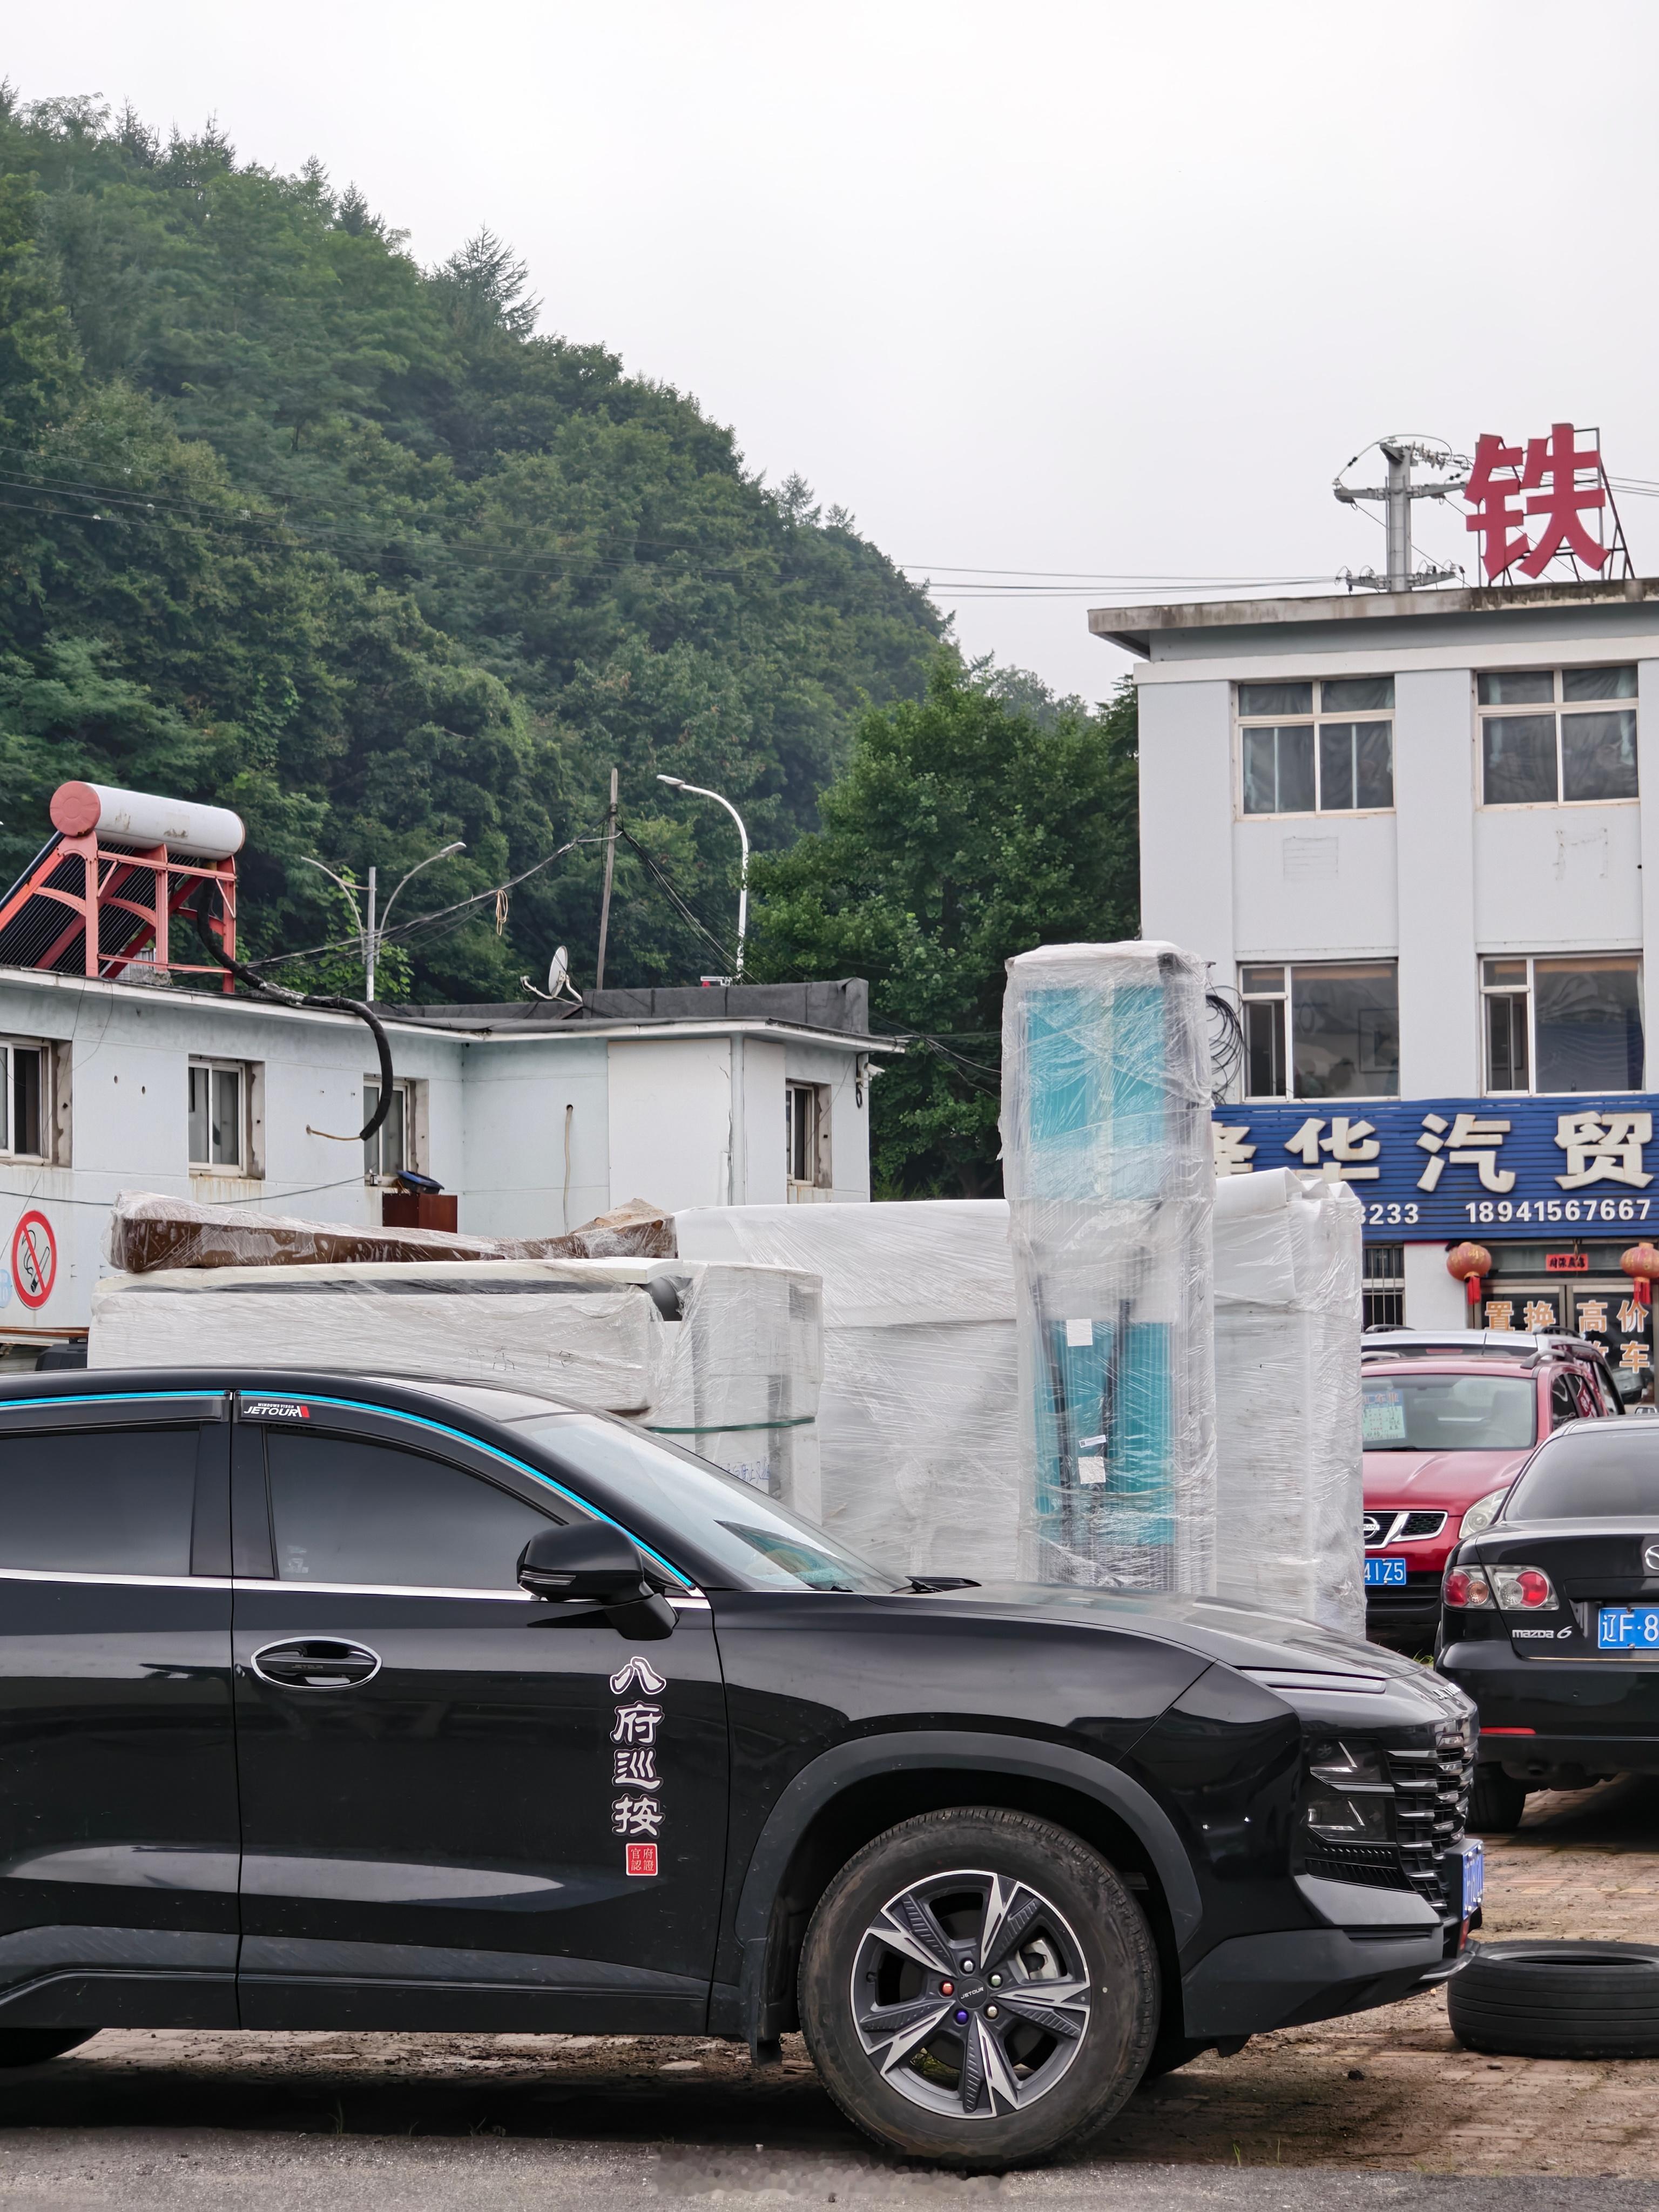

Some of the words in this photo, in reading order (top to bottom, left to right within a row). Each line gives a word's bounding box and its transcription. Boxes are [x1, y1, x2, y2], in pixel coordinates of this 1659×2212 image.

[1464, 422, 1611, 582] 铁
[1465, 1199, 1651, 1223] 18941567667
[244, 1406, 299, 1417] JETOUR
[1556, 1626, 1573, 1639] 6
[610, 1656, 666, 1839] 八府巡按
[960, 1987, 984, 1999] JETOUR
